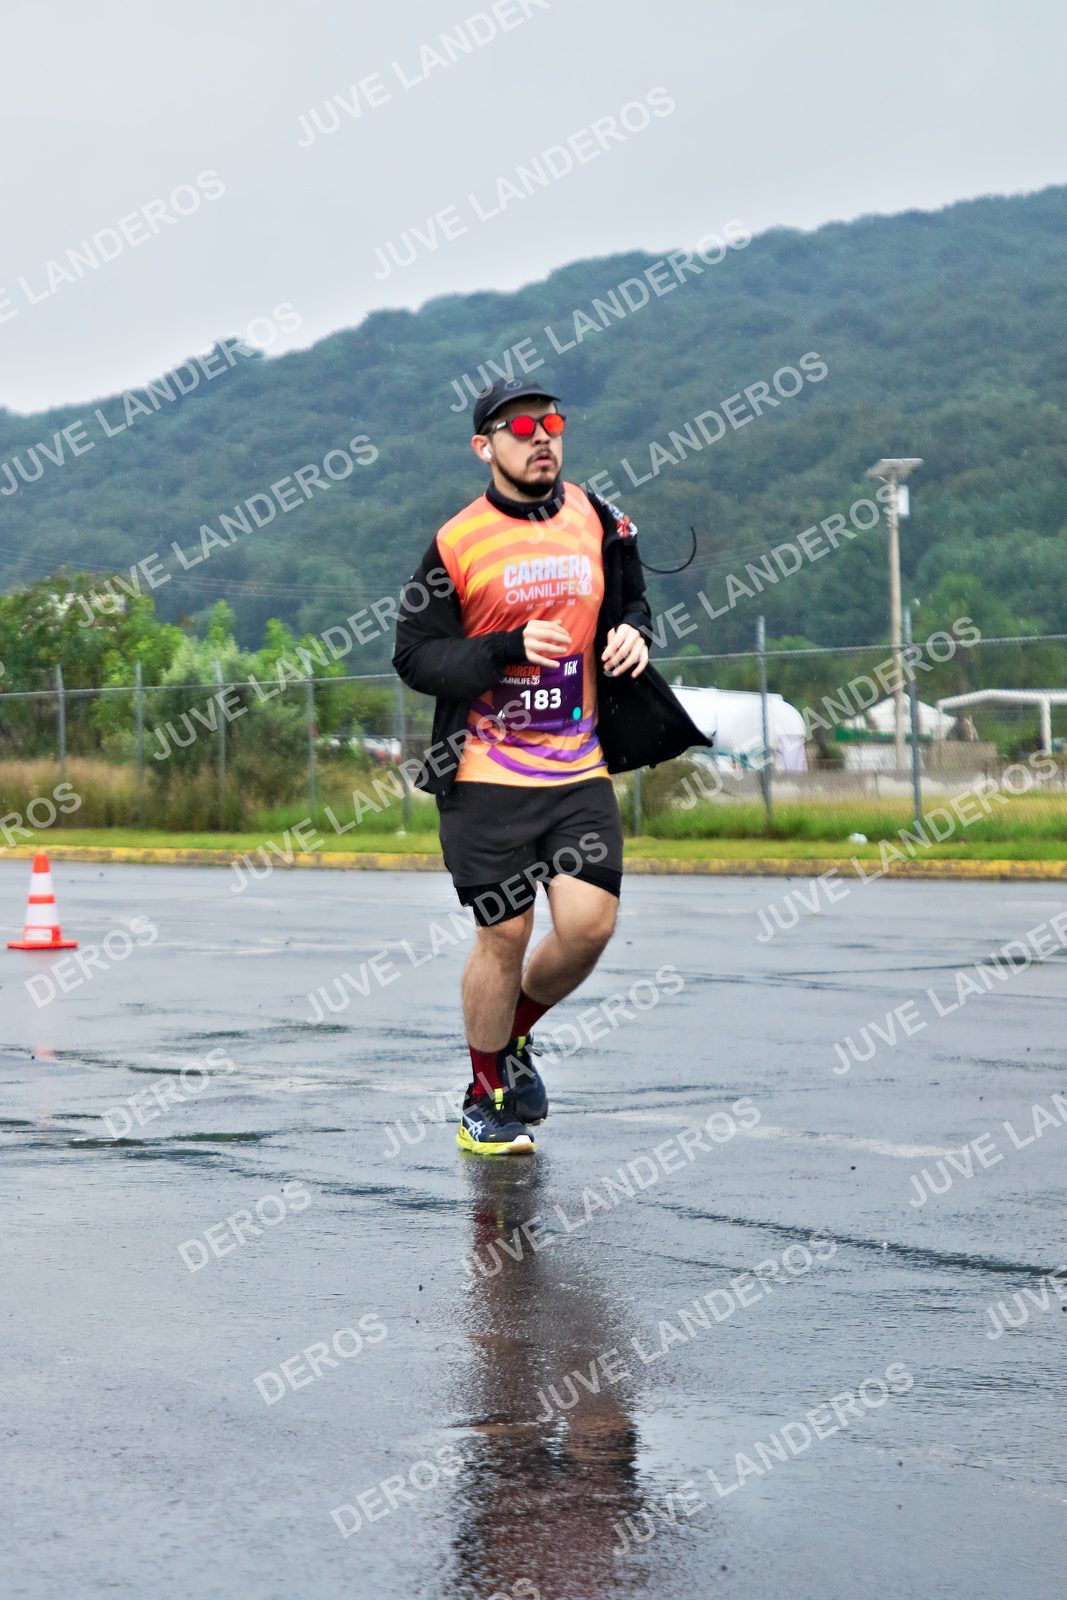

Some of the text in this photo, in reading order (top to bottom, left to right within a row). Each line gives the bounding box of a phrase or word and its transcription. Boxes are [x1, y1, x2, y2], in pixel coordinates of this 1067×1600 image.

[503, 555, 592, 588] CARRERA
[505, 580, 576, 605] OMNILIFE
[504, 664, 541, 677] ARRERA
[520, 687, 561, 710] 183
